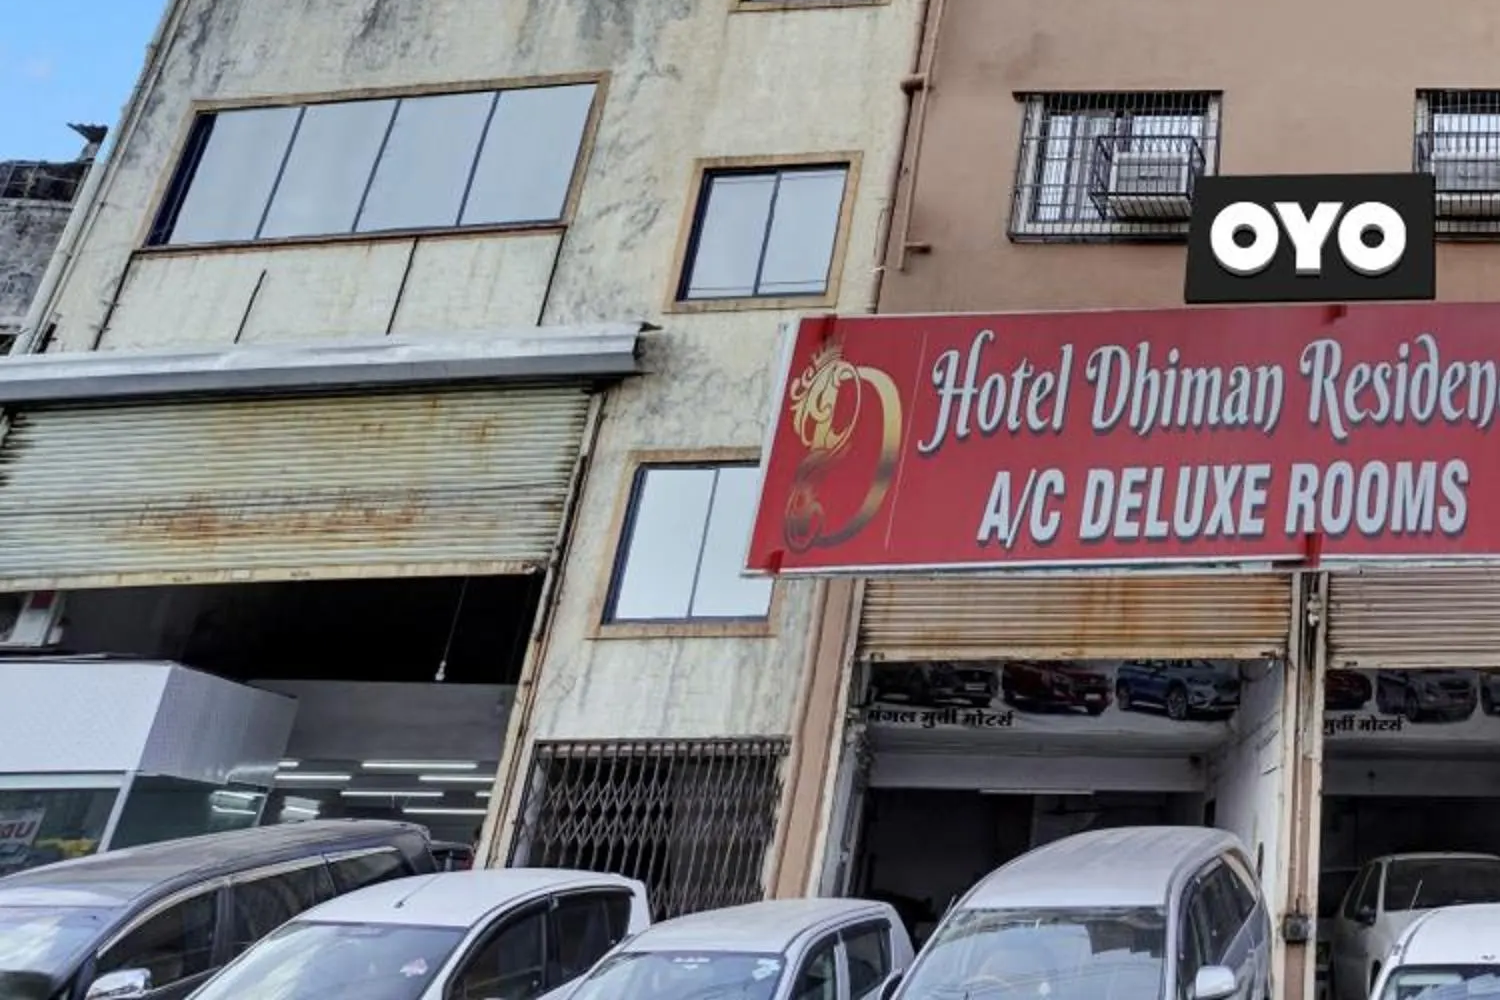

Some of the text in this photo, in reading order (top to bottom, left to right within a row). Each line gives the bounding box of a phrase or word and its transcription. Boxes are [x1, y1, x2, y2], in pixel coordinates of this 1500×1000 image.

[1209, 200, 1407, 277] OYO
[917, 328, 1074, 454] Hotel
[1085, 339, 1284, 438] Dhiman
[976, 459, 1470, 550] A/C DELUXE ROOMS
